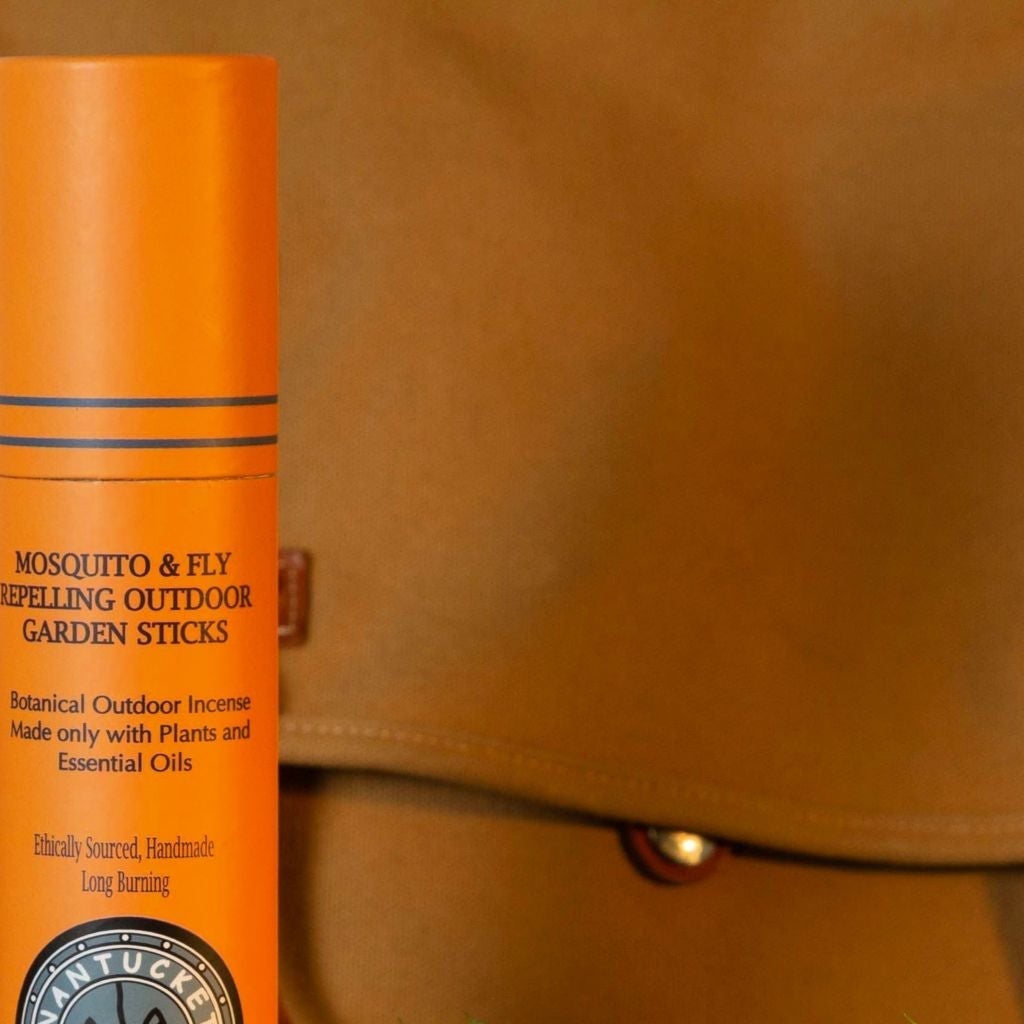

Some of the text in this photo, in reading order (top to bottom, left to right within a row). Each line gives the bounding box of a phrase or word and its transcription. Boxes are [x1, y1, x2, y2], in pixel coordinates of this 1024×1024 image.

[16, 551, 232, 580] MOSQUITO & FLY
[0, 583, 252, 611] REPELLING OUTDOOR
[23, 619, 228, 645] GARDEN STICKS
[11, 691, 251, 714] Botanical Outdoor Incense
[11, 720, 250, 748] Made only with Plants and
[59, 752, 192, 772] Essential Oils
[33, 833, 214, 863] Ethically Sourced, Handmade
[82, 870, 170, 898] Long Burning
